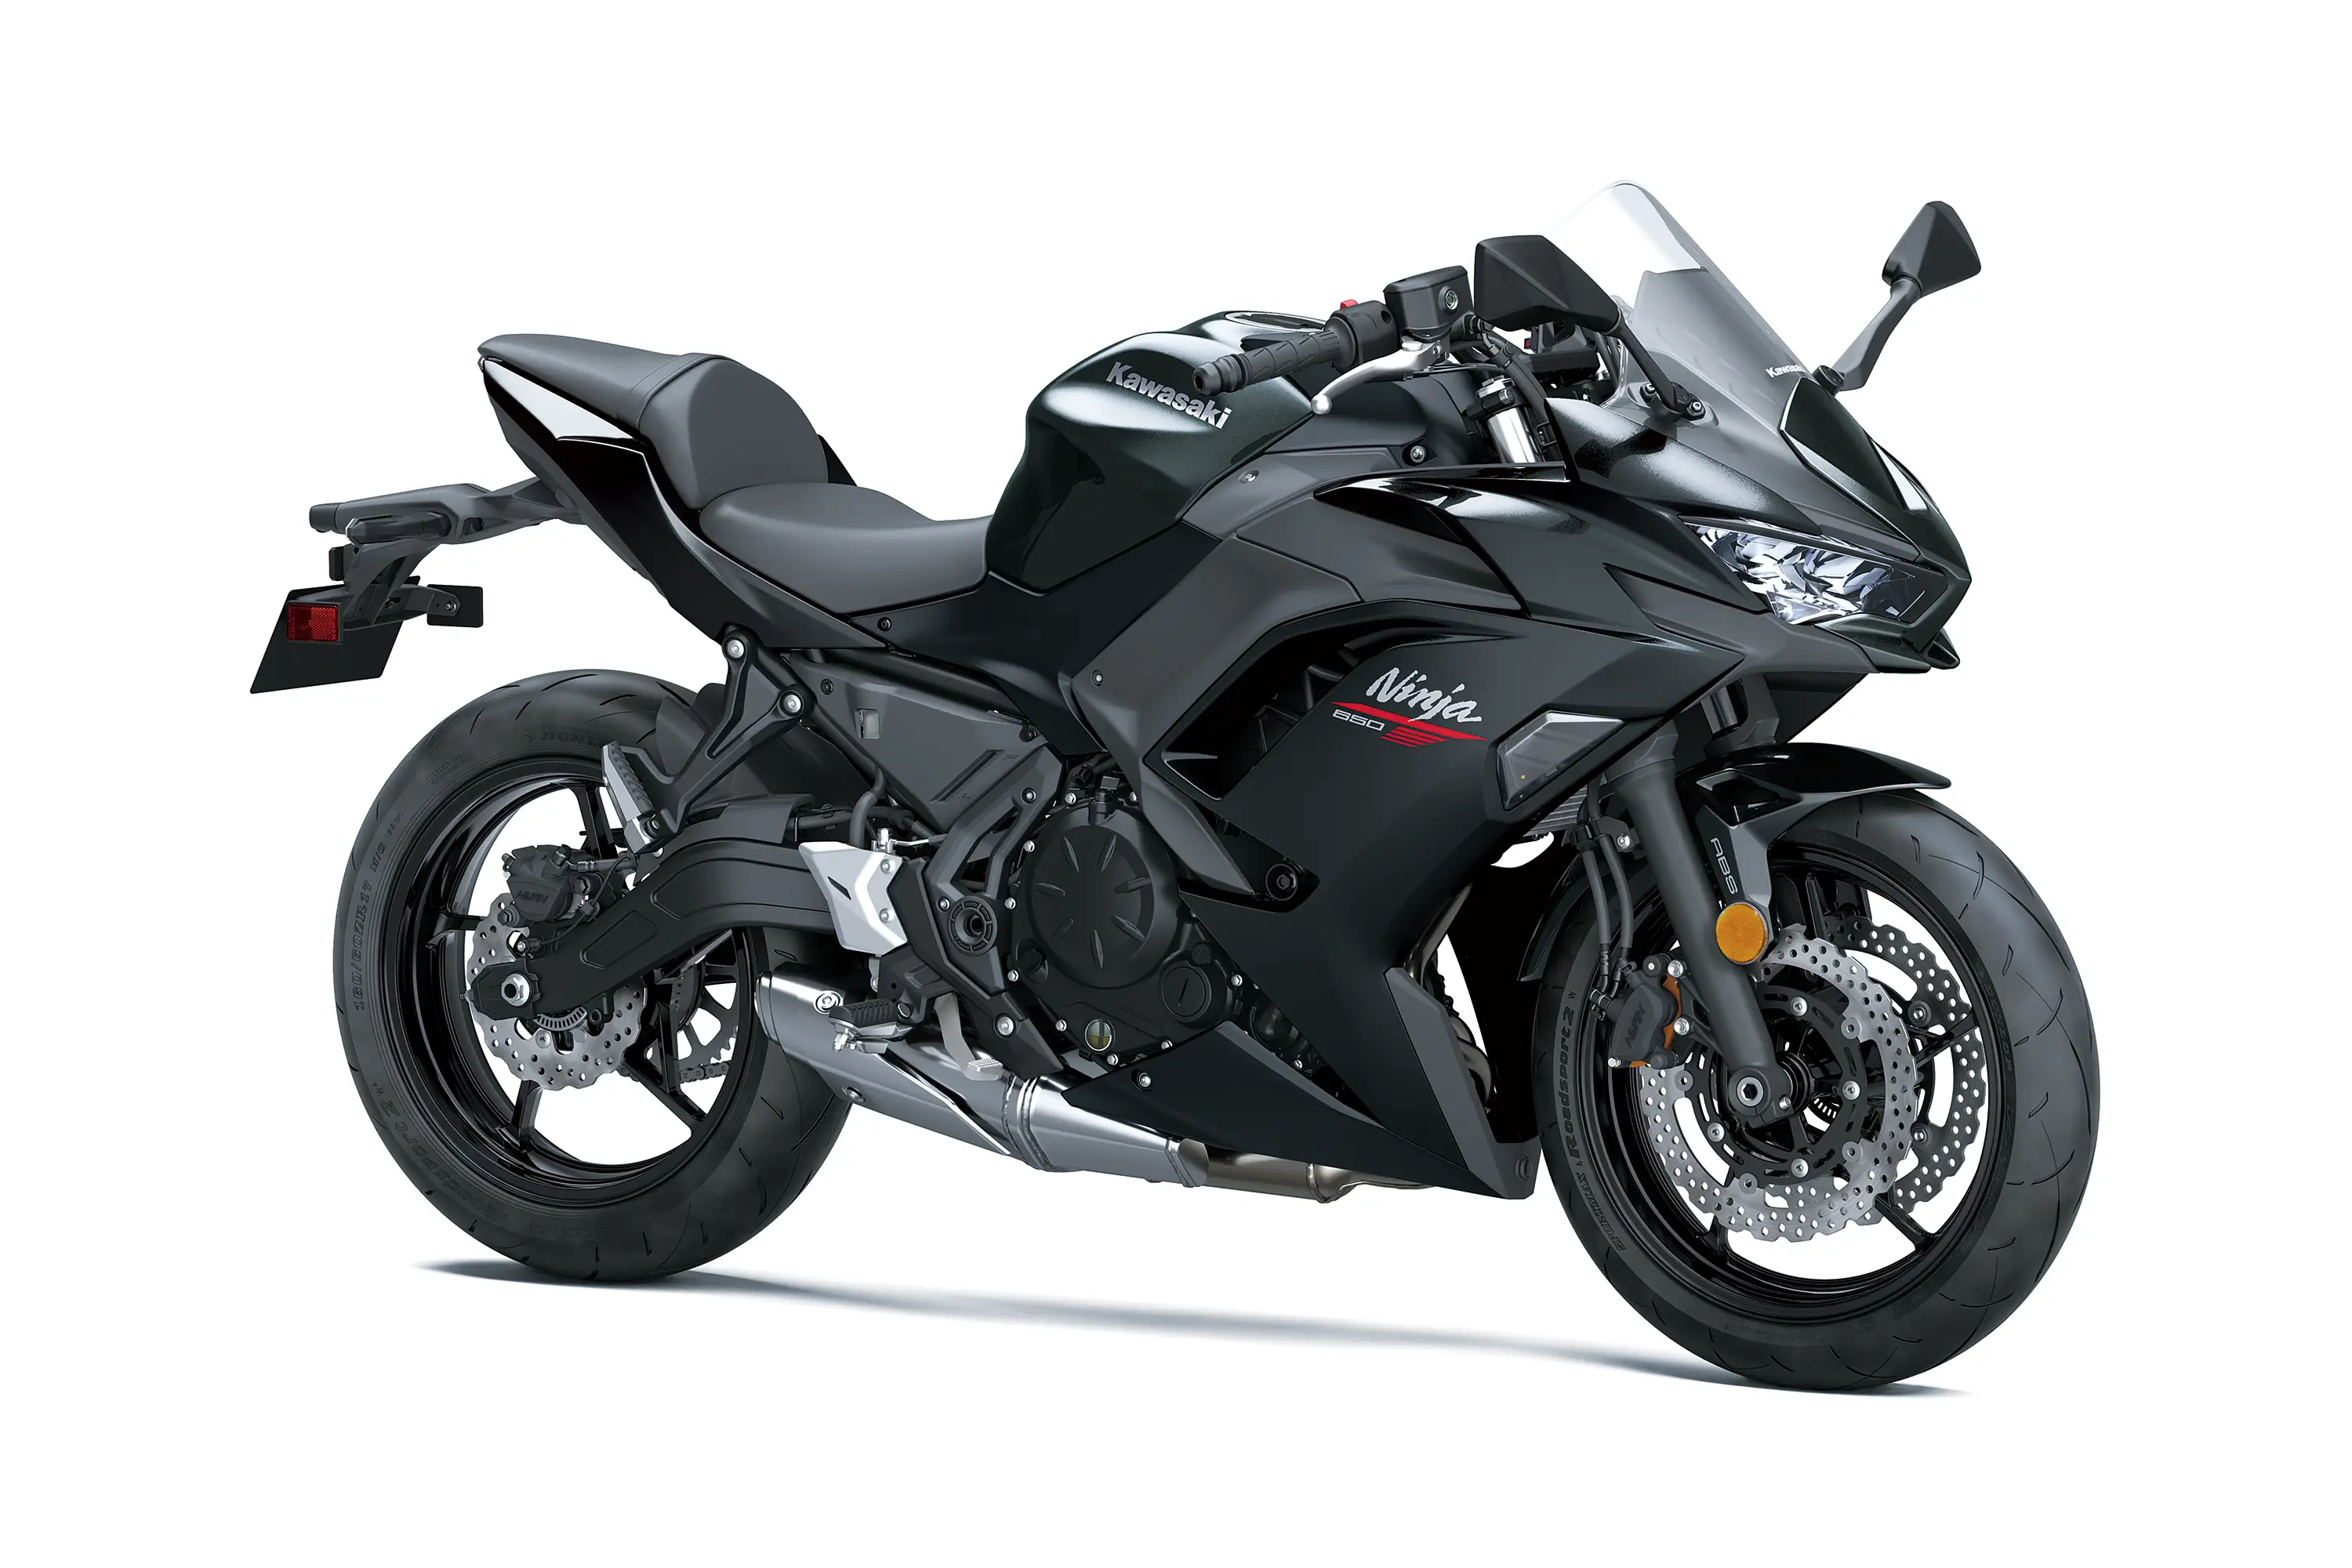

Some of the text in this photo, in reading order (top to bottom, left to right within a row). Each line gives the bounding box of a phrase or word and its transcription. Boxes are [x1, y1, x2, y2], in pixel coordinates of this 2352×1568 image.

[1106, 361, 1232, 430] Kawasaki
[1333, 709, 1385, 731] 650
[1366, 667, 1482, 722] Ninja
[539, 730, 607, 747] DUNL
[1711, 837, 1738, 895] ABS
[351, 879, 372, 1011] 160/60ZR17
[1563, 1007, 1575, 1026] 2
[1558, 1026, 1581, 1159] Roadsport
[1576, 1172, 1626, 1250] SPORTMAX
